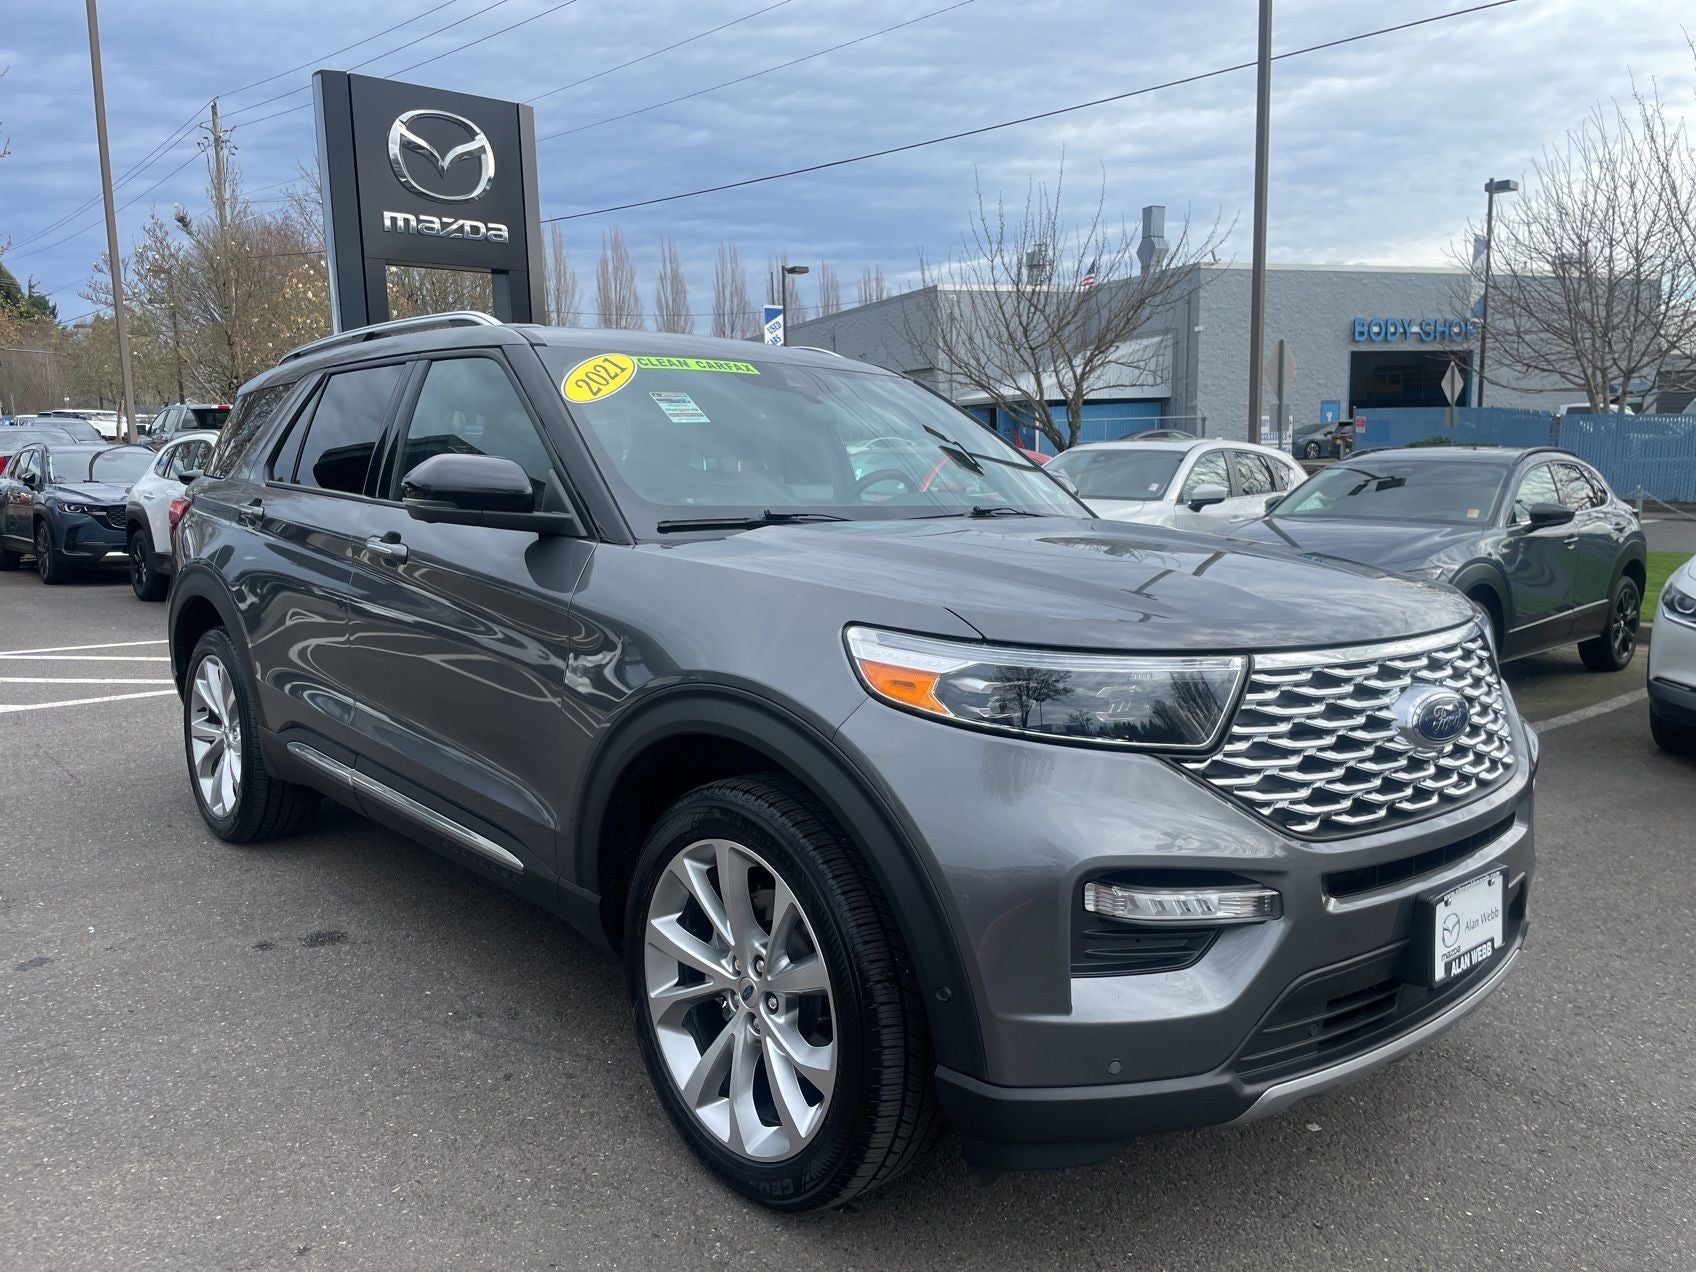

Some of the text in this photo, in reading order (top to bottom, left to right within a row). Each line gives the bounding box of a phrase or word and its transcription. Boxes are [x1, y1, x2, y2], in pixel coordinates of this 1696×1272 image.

[383, 211, 509, 243] mazda
[767, 321, 781, 334] USED
[1353, 318, 1412, 341] BODY
[575, 357, 628, 397] 2021
[637, 358, 755, 373] CLEAN CARFAX
[1433, 704, 1462, 734] Ford
[1465, 906, 1499, 933] Alan Webb
[1450, 941, 1492, 977] ALAN WEBB
